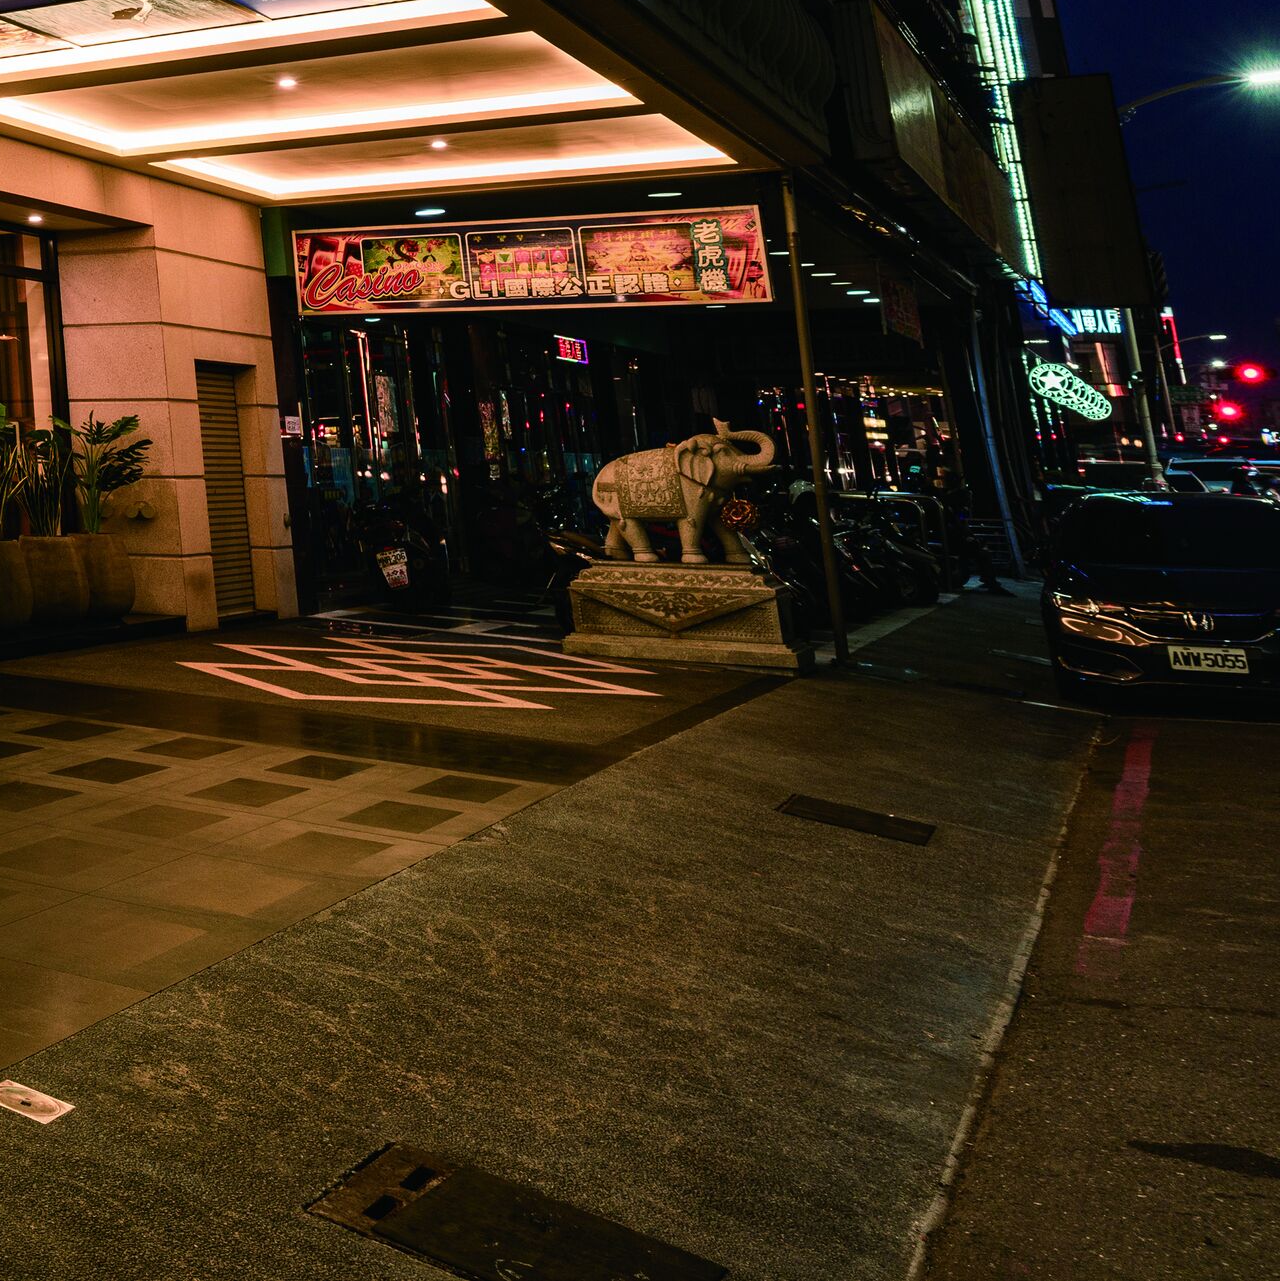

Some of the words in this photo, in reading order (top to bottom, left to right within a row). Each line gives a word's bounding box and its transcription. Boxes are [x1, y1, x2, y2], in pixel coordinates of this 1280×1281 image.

[305, 261, 425, 309] Casino
[693, 220, 729, 293] 老虎機
